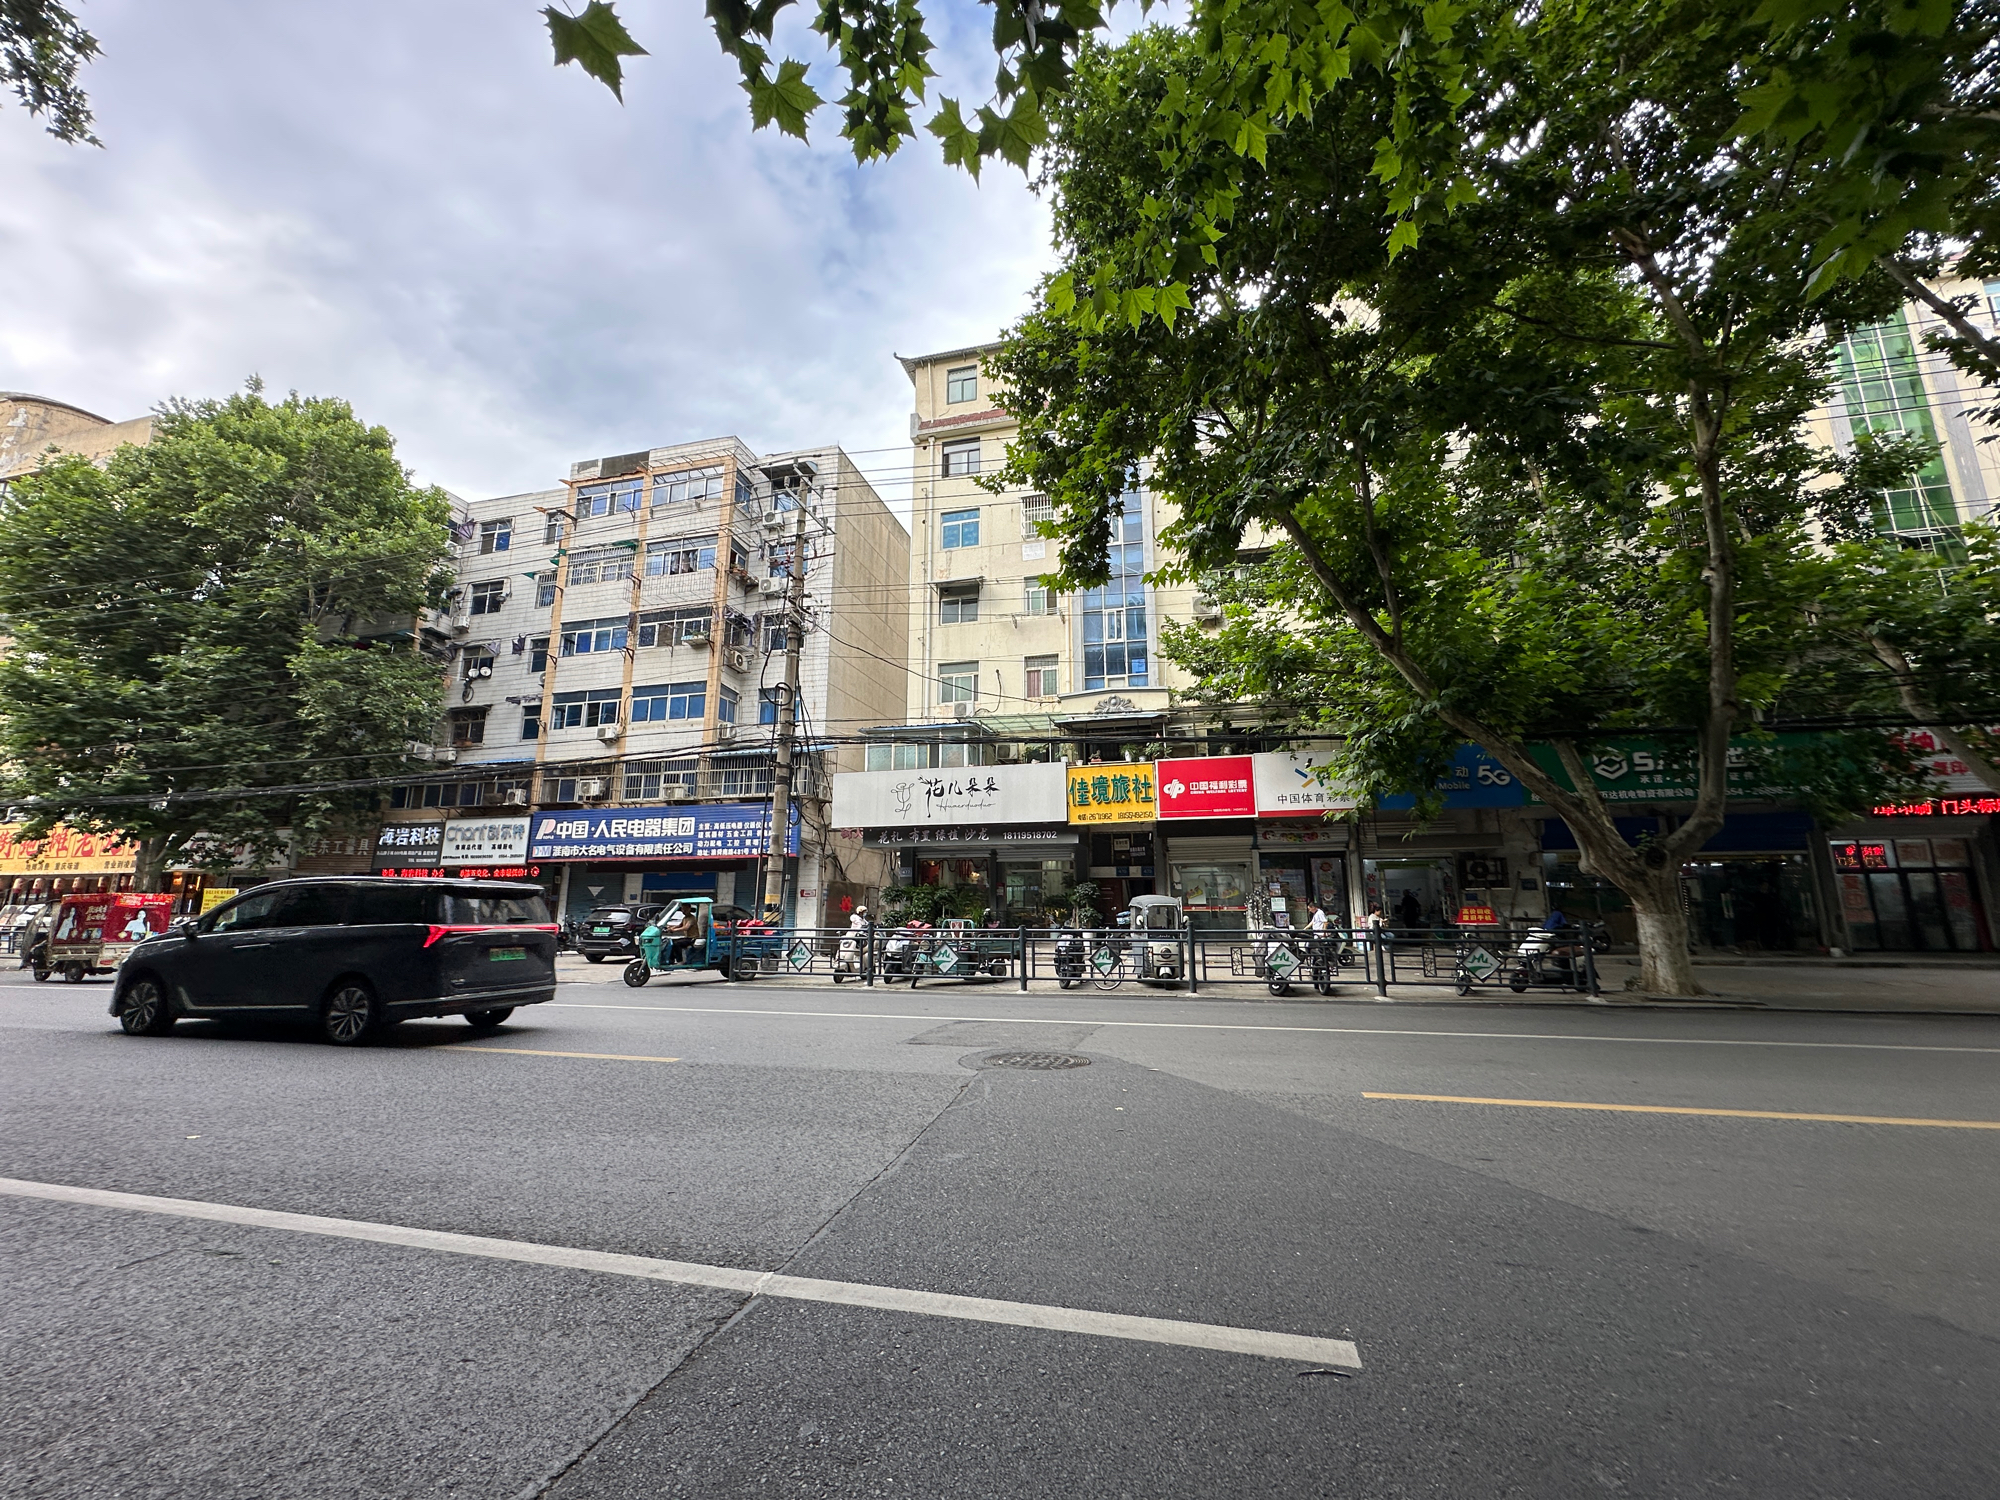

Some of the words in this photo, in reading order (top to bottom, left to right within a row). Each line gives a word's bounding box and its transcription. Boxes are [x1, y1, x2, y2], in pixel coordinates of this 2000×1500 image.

[1190, 780, 1248, 791] 中国福利彩票
[1477, 765, 1511, 786] 5G
[1069, 774, 1152, 807] 佳境旅社
[378, 827, 442, 846] 海岩科技
[556, 817, 695, 839] 中国·人民电器集团
[1002, 830, 1058, 840] 18119518702
